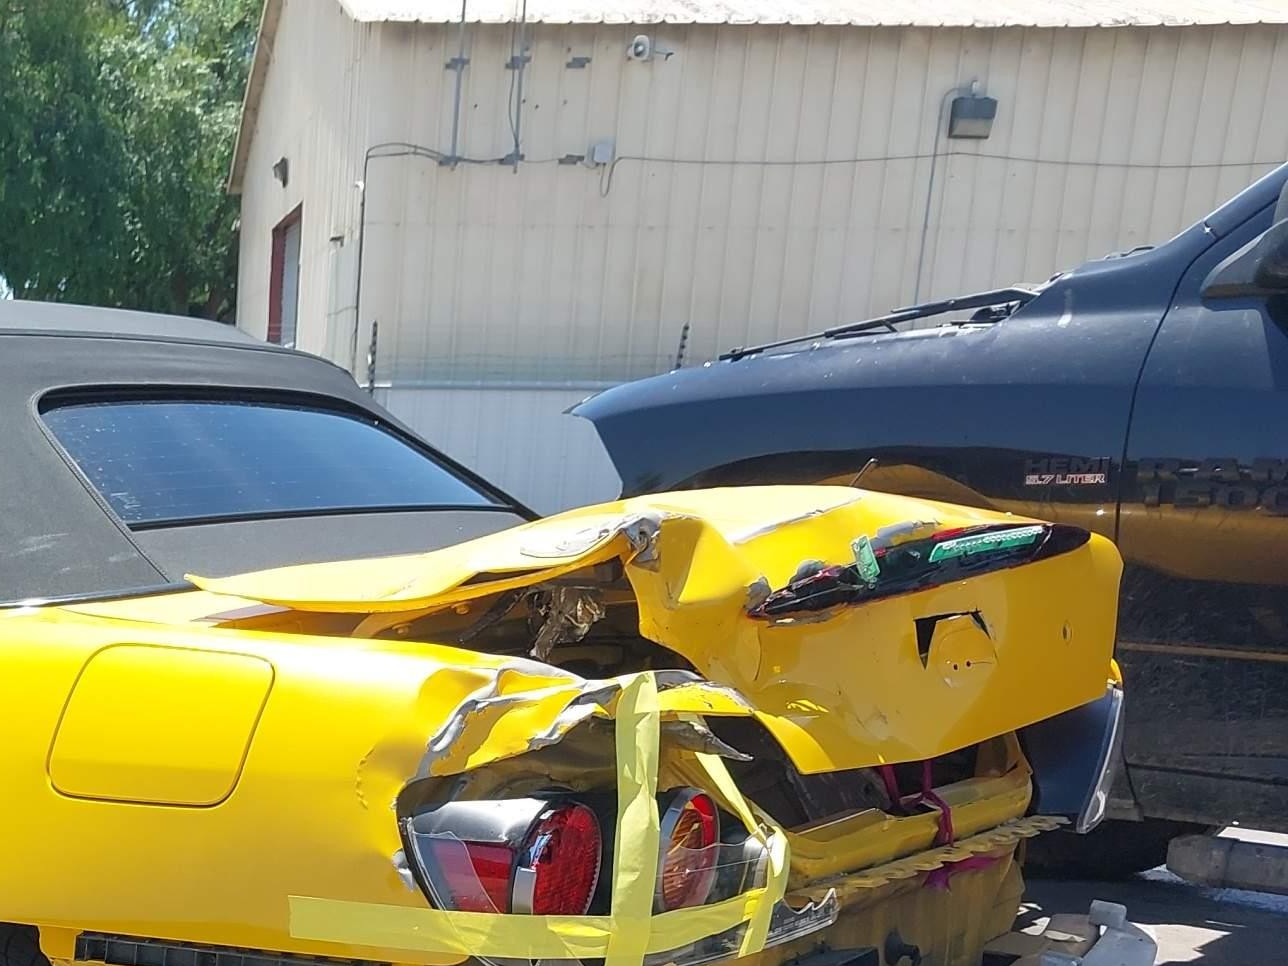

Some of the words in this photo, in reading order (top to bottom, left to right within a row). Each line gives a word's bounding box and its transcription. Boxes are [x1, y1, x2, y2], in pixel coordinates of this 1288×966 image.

[1024, 457, 1112, 473] HEMI
[1025, 475, 1054, 486] 5.7
[1056, 474, 1106, 485] LITER
